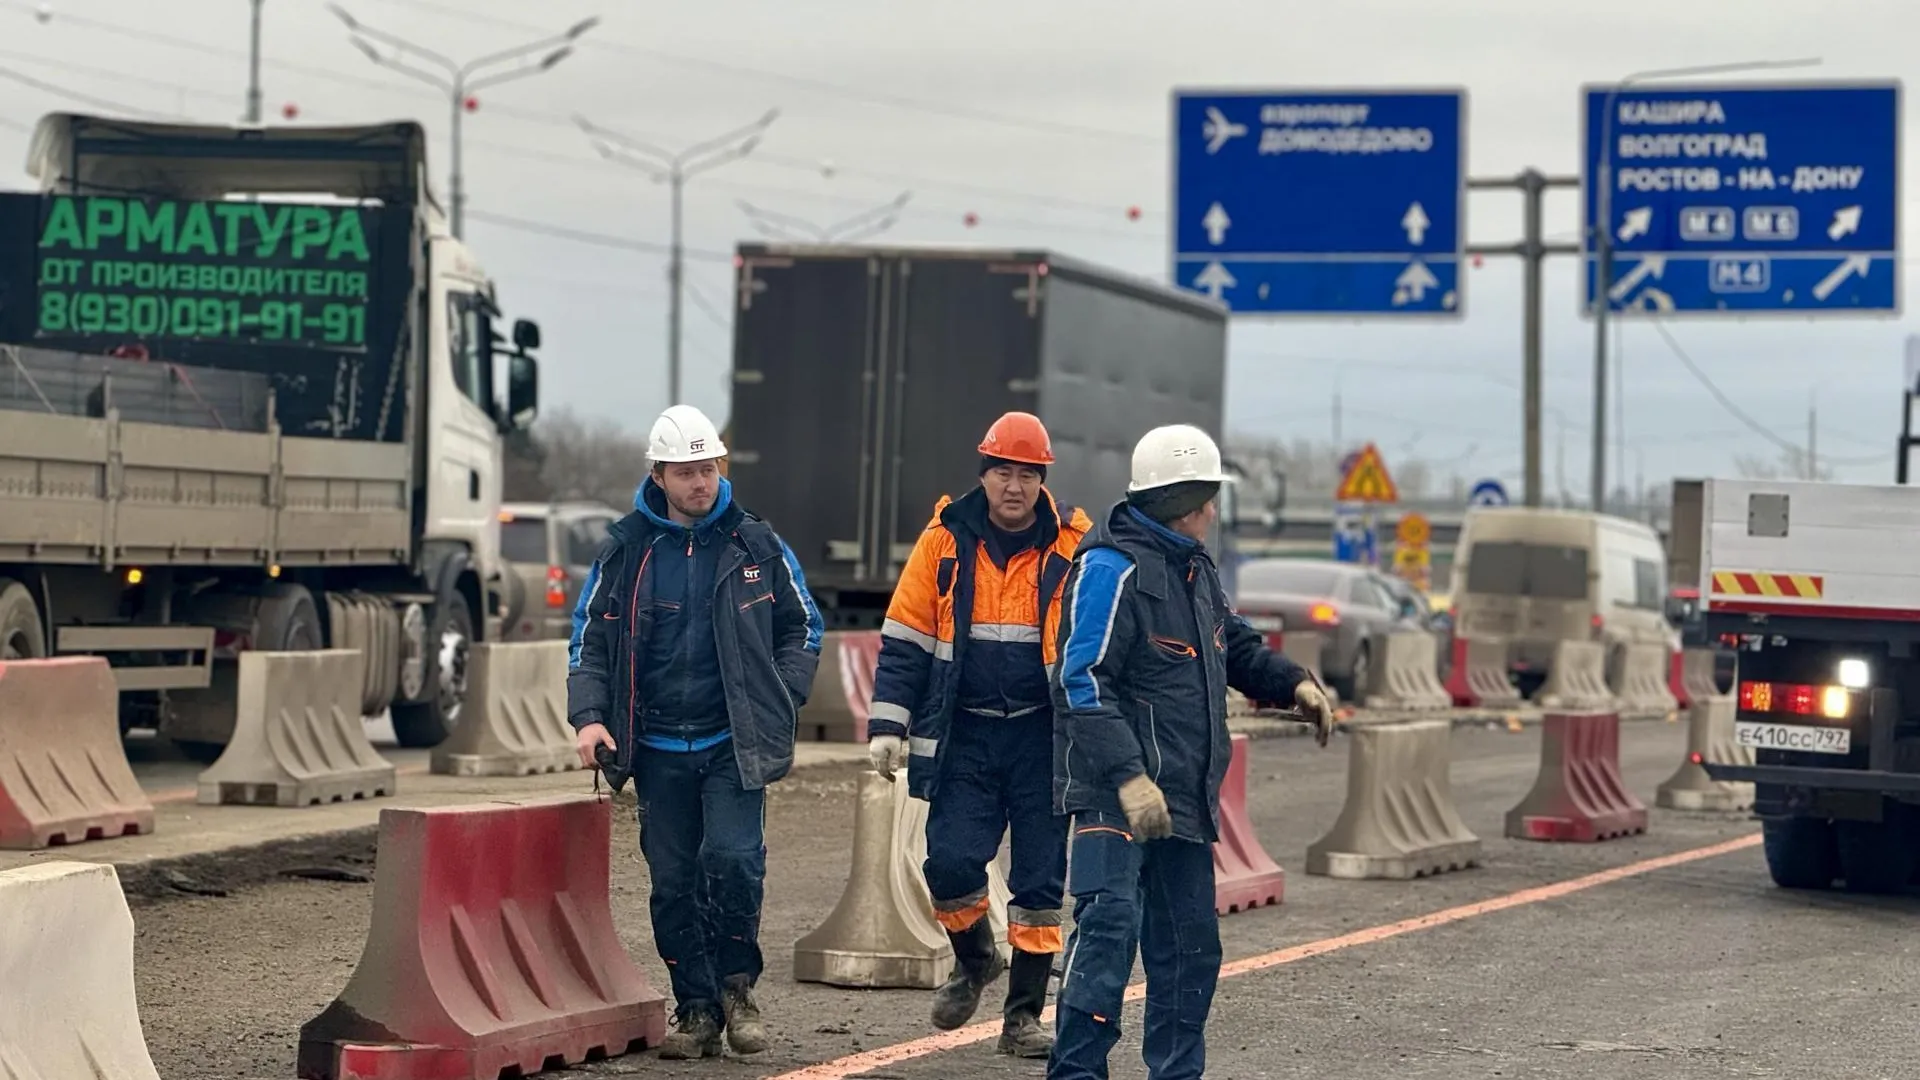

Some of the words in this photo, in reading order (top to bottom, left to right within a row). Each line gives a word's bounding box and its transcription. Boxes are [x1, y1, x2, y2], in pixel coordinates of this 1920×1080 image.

[1618, 100, 1725, 124] КАШИРА
[1618, 133, 1767, 159] ВОЛГОГРАД
[42, 197, 370, 260] АРМАТУРА
[42, 258, 85, 285] ОТ
[91, 260, 367, 298] ПРОИЗВОДИТЕЛЯ
[40, 291, 366, 342] 8(930)091-91-91
[1816, 729, 1844, 745] 797
